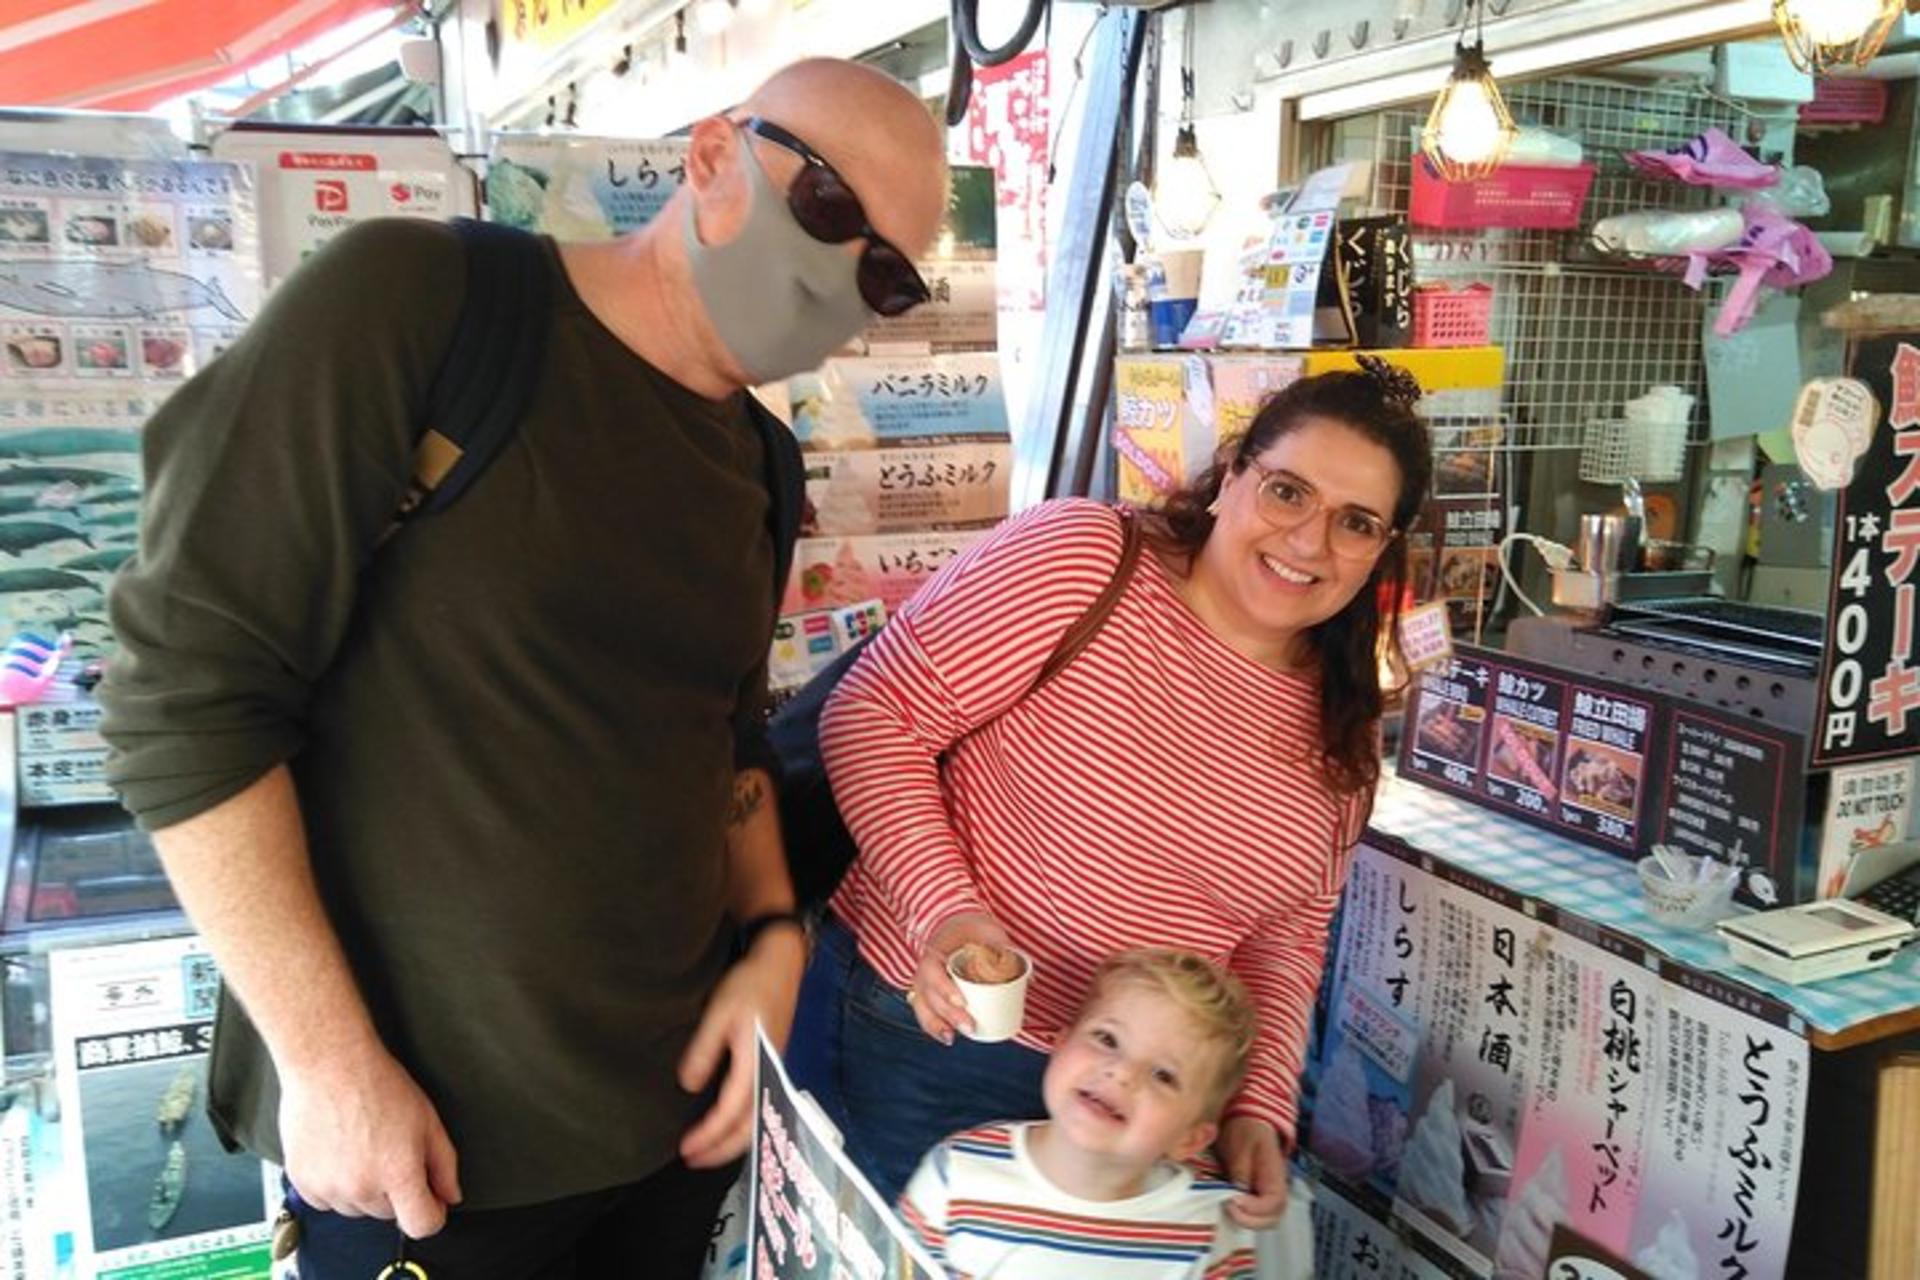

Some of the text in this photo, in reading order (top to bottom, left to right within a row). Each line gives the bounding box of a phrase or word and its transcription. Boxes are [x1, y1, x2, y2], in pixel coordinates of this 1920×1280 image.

[872, 372, 988, 398] バニラミルク
[879, 461, 997, 490] とうふミルク
[1845, 511, 1881, 543] 1本
[1823, 547, 1873, 751] 400円
[1385, 880, 1416, 1008] しらす
[1479, 925, 1518, 1074] 日本酒
[1589, 979, 1641, 1214] 白桃シャーベット
[1716, 1033, 1775, 1280] とうふミルク
